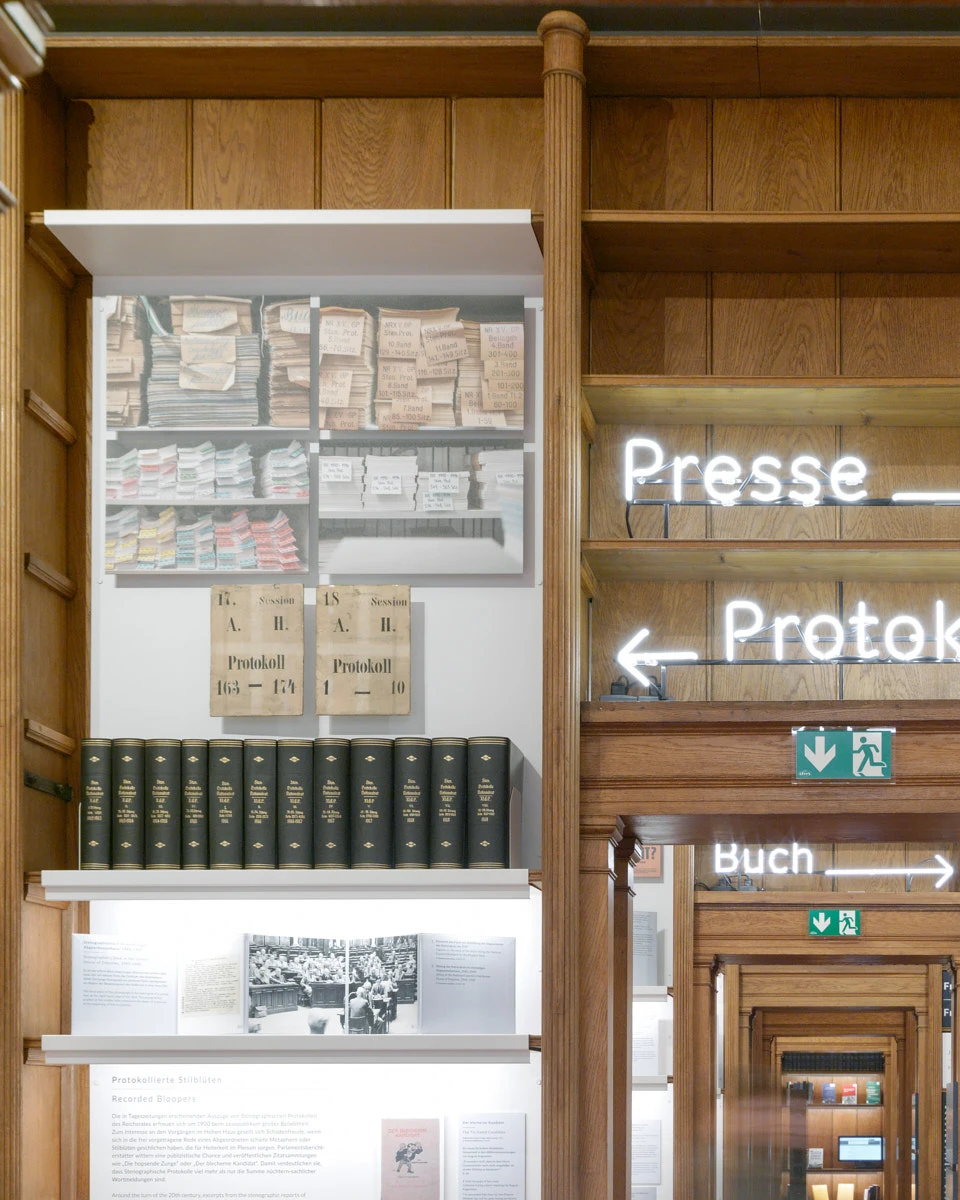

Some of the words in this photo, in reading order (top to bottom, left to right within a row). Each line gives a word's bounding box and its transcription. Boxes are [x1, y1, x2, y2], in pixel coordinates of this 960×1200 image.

[625, 437, 868, 502] Presse
[259, 595, 295, 605] Session
[370, 597, 408, 607] Session
[226, 617, 241, 632] A.
[274, 616, 289, 631] H.
[333, 618, 349, 632] A.
[381, 617, 396, 632] H.
[228, 654, 285, 670] Protokoll
[333, 658, 392, 674] Protokoll
[216, 680, 240, 695] 163
[391, 680, 405, 695] 10
[715, 843, 813, 874] Buch
[112, 1076, 175, 1084] Protokollierte
[178, 1075, 222, 1084] Stilblüten
[112, 1094, 153, 1103] Recorded
[157, 1094, 196, 1104] Bloopers
